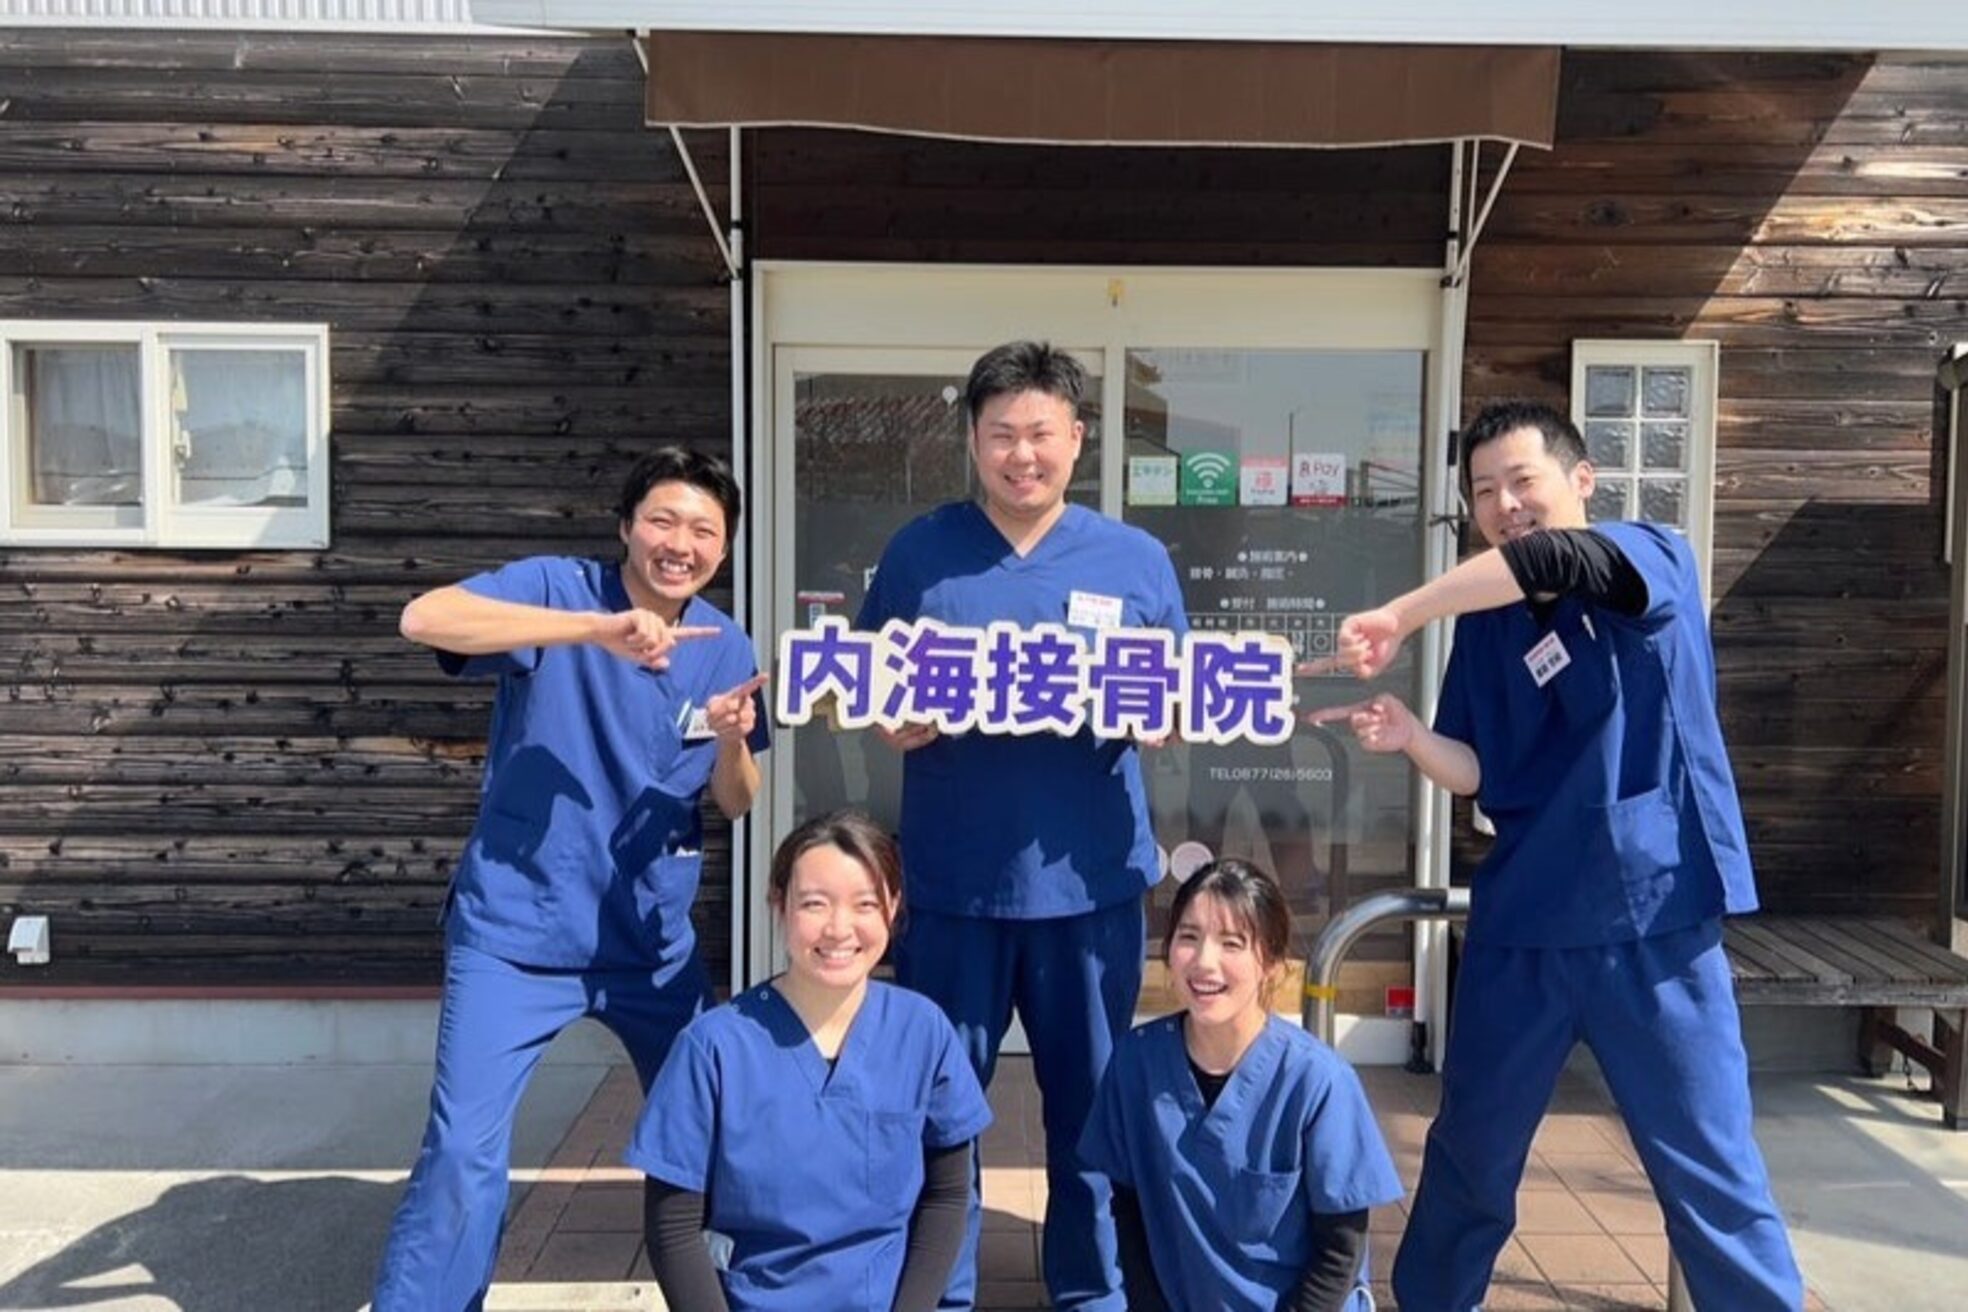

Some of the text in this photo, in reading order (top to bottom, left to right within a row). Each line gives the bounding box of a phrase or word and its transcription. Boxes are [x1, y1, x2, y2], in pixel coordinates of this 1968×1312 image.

[785, 624, 1285, 738] 内海接骨院
